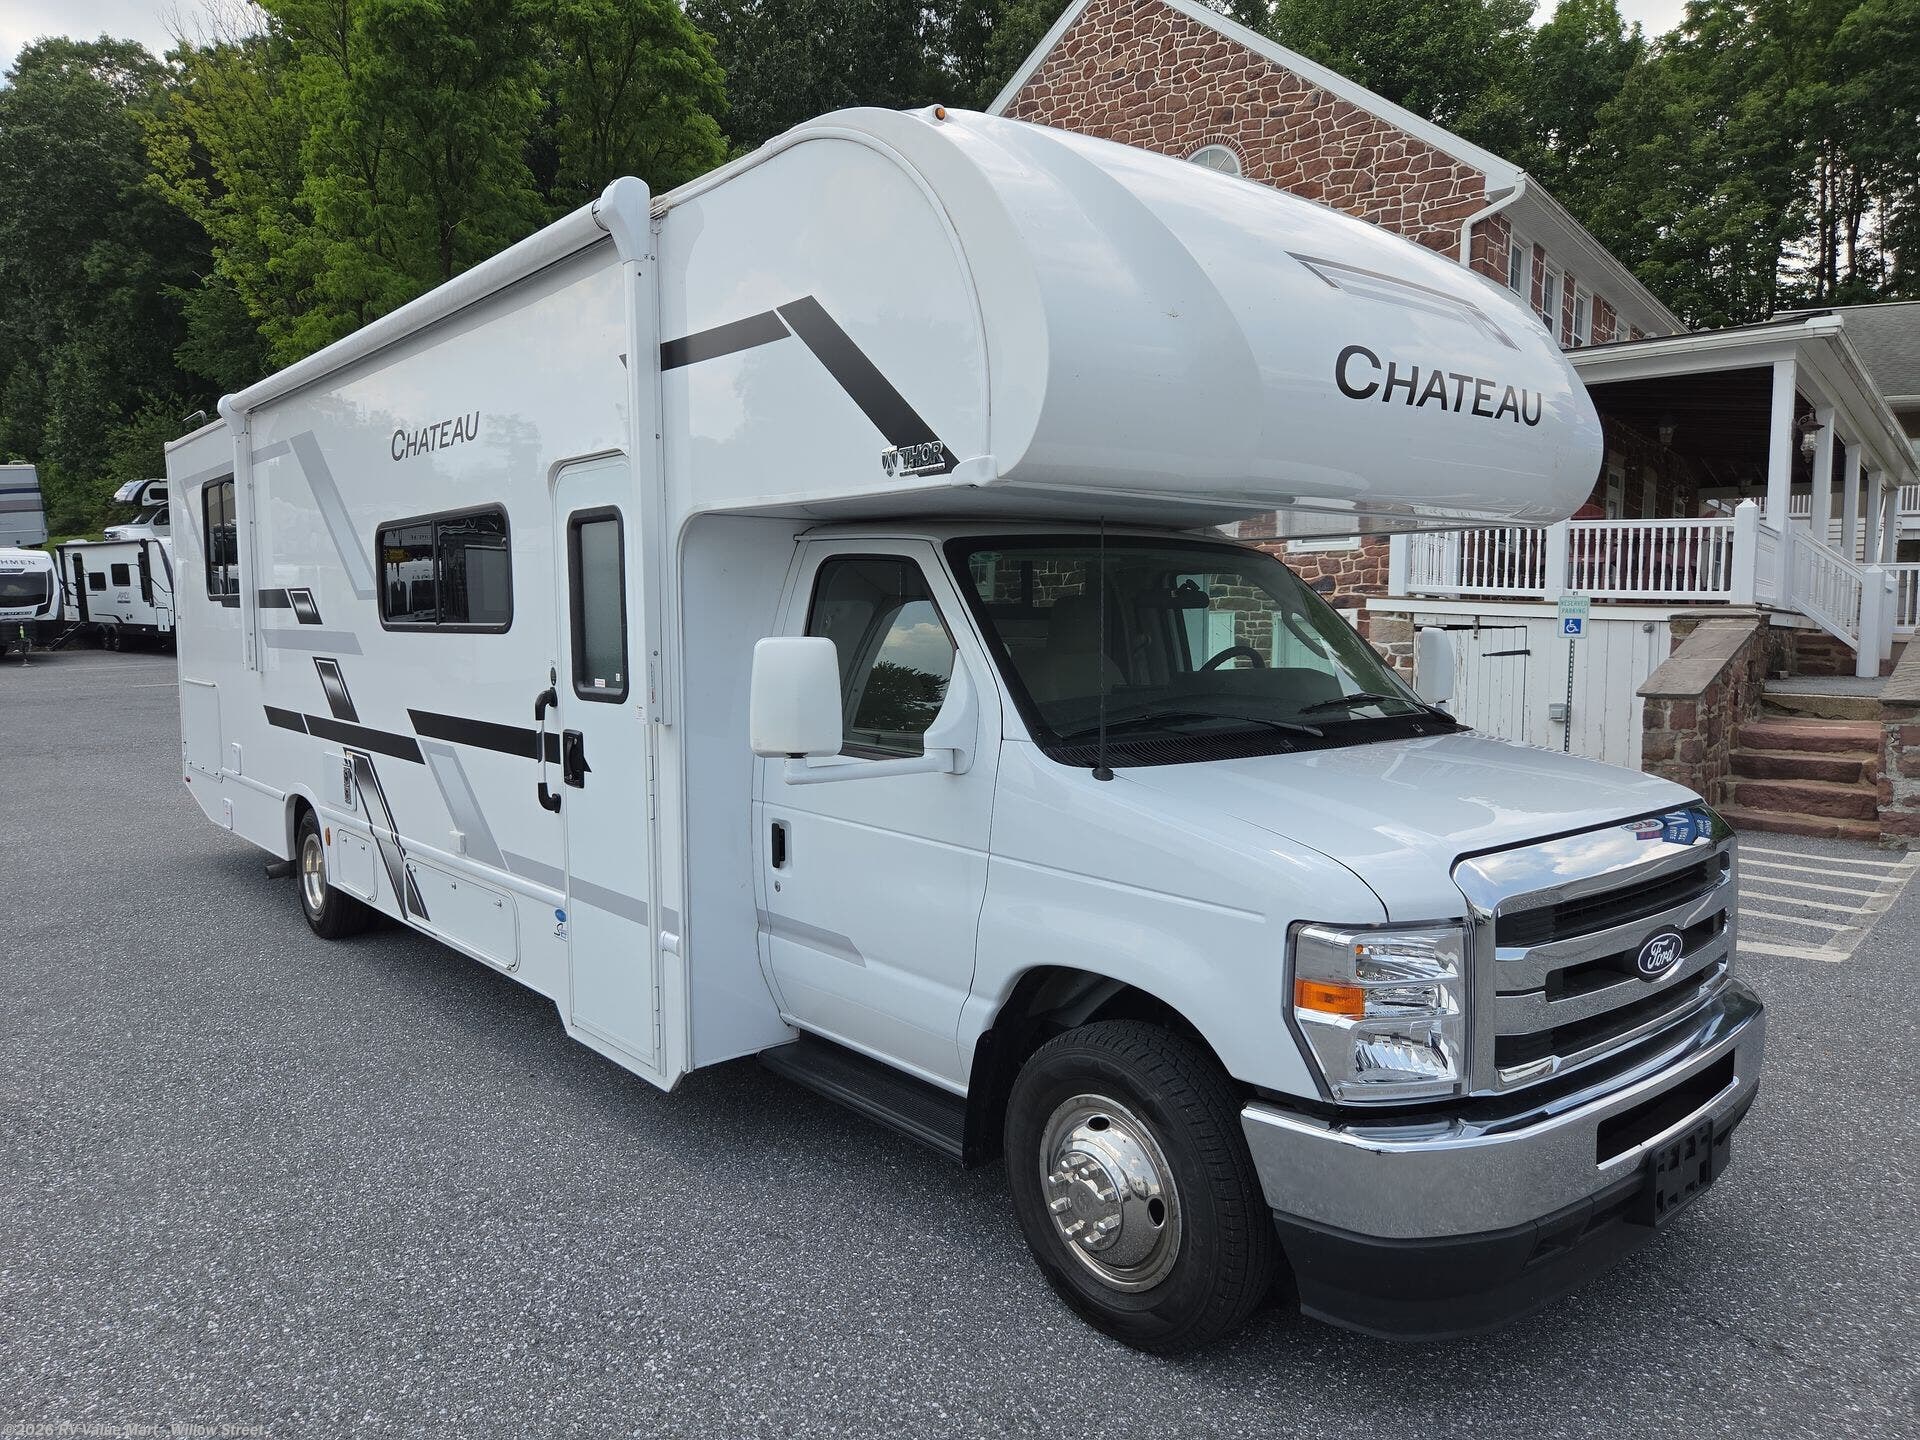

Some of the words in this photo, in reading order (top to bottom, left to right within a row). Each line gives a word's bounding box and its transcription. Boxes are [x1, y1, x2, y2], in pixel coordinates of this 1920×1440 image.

[1335, 345, 1542, 427] CHATEAU
[391, 411, 480, 462] CHATEAU
[899, 440, 945, 469] THOR
[1647, 939, 1676, 970] Ford
